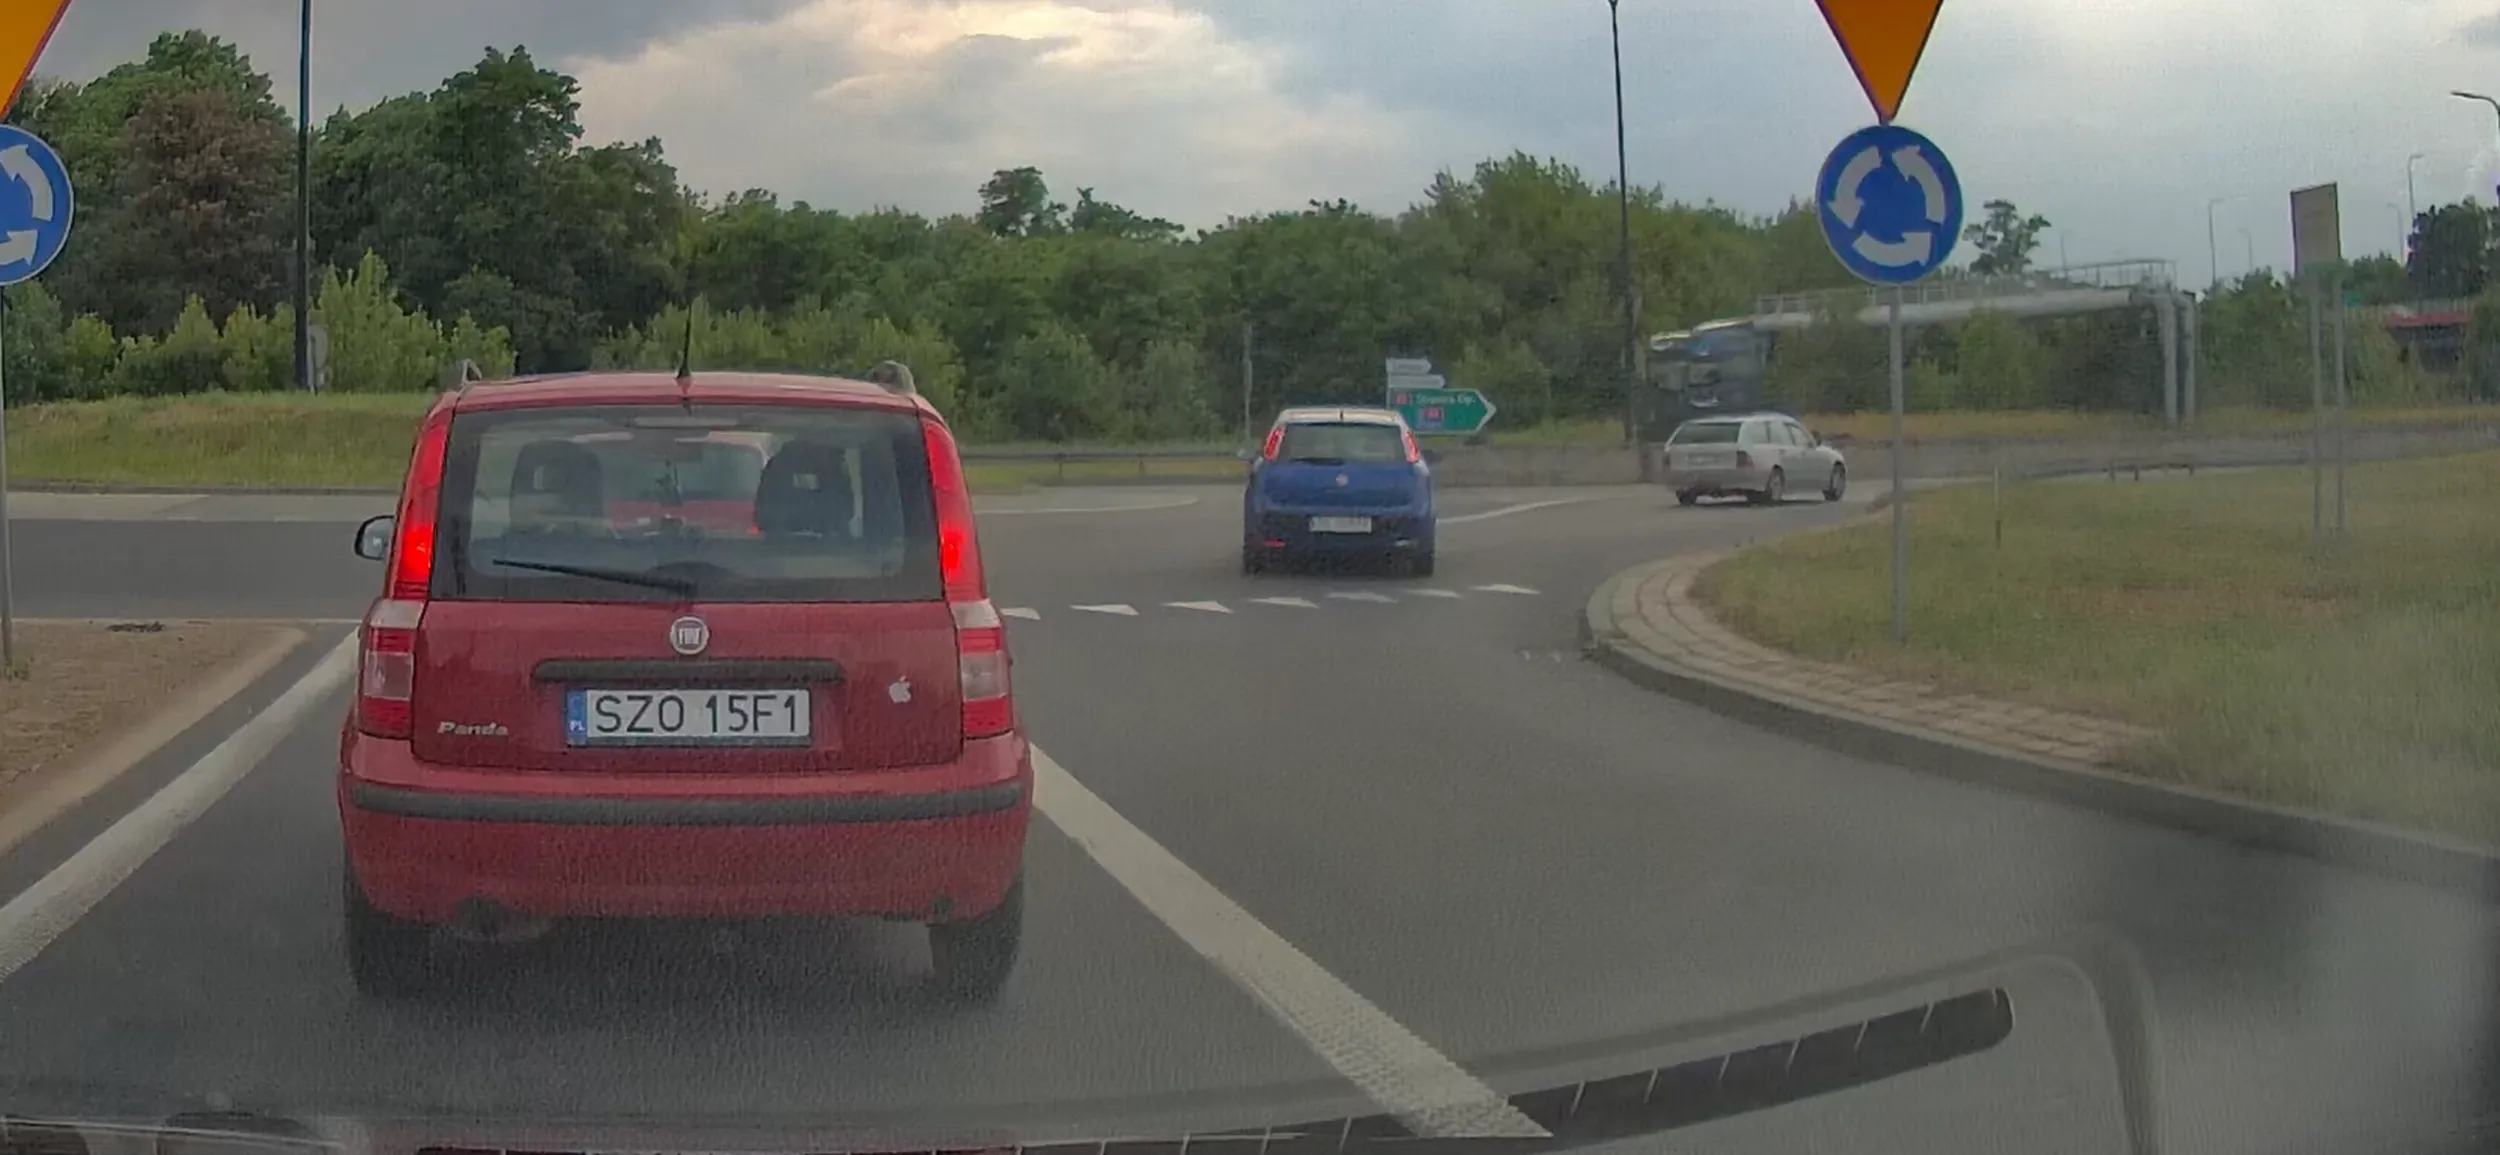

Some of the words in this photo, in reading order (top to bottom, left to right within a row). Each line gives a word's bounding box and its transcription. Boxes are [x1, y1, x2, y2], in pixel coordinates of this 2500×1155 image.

[595, 695, 685, 733] SZO
[705, 695, 796, 733] 15F1
[437, 721, 509, 736] Panda
